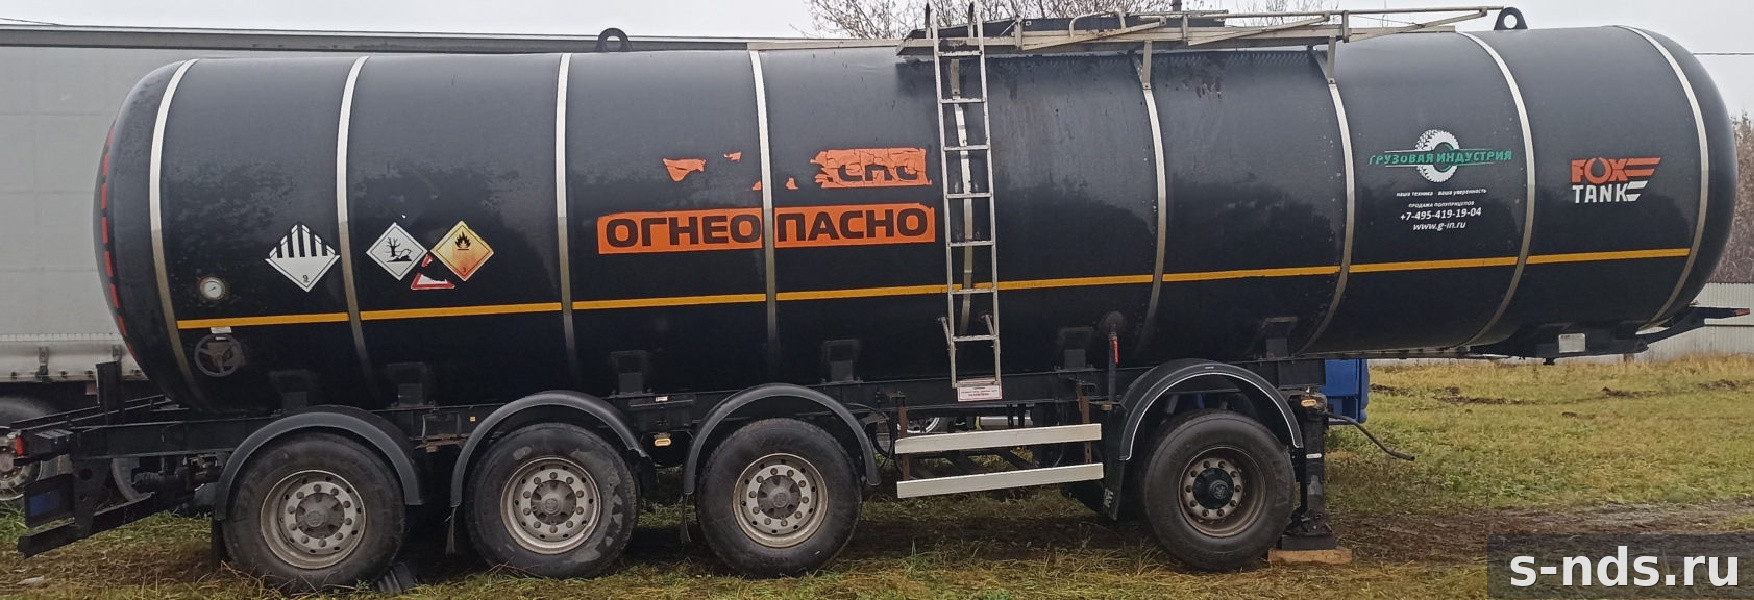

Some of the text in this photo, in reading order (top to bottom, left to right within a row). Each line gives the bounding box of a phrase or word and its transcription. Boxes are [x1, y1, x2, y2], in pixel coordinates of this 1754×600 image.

[1369, 150, 1512, 165] ГРУЗОВАЯ ИНДУСТРИЯ
[1571, 157, 1628, 184] FOX
[1572, 183, 1628, 203] TANK
[1400, 207, 1482, 221] +7-495-419-19-04
[606, 208, 928, 249] ОГНЕОПАСНО
[1412, 222, 1466, 231] www.g-in.ru
